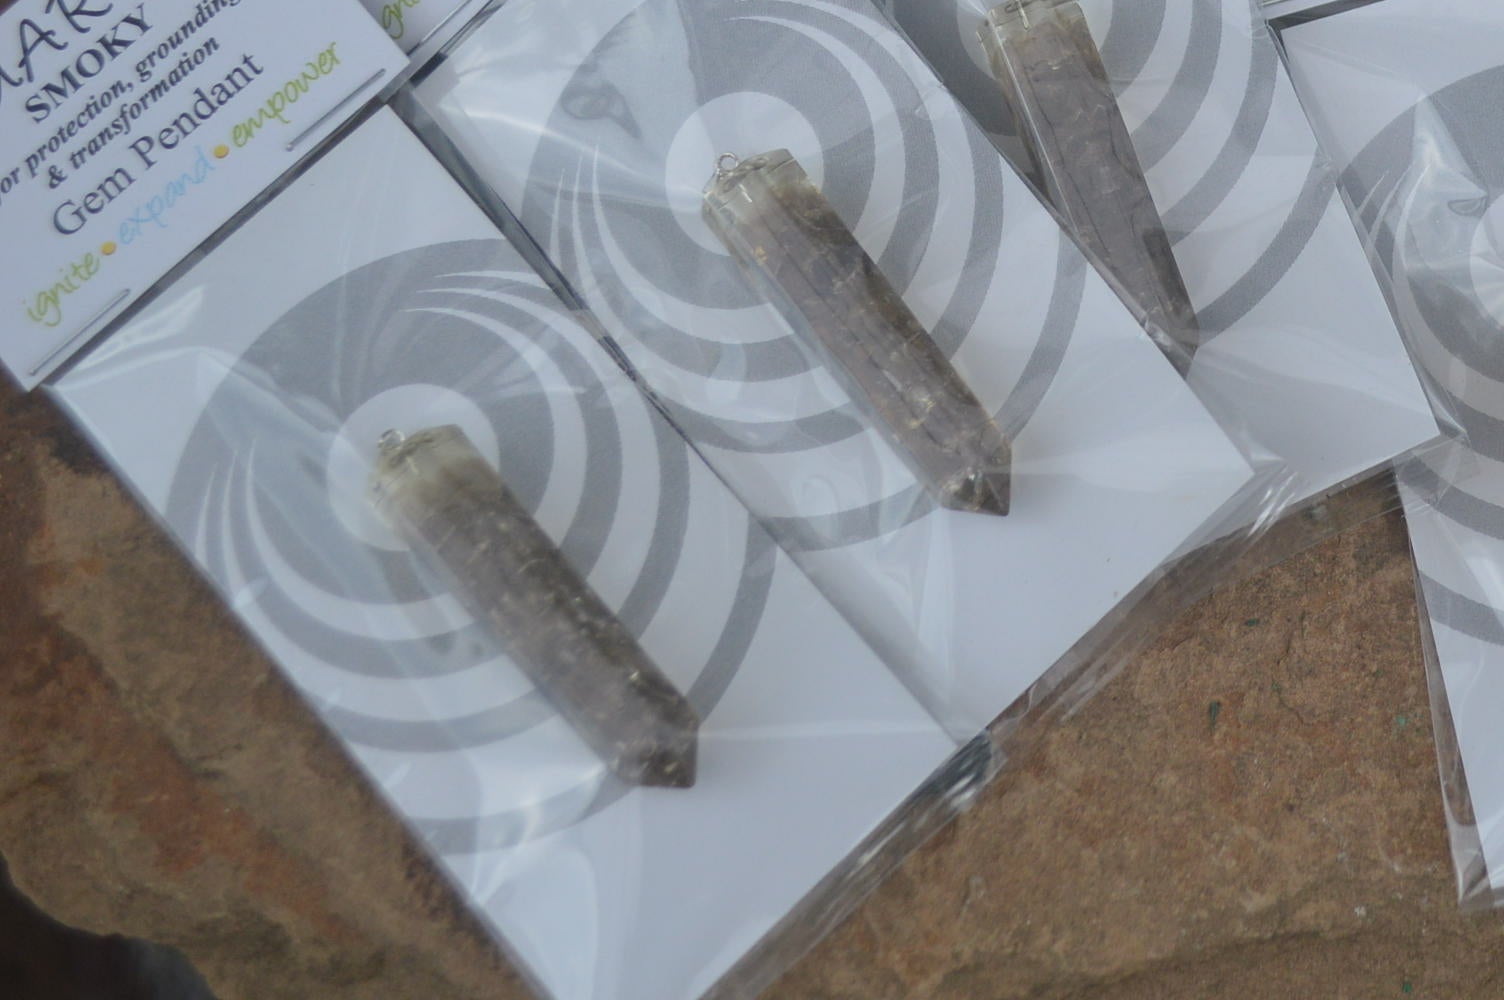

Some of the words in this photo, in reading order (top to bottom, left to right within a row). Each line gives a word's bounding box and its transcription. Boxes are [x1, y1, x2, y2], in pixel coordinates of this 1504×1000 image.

[0, 166, 20, 196] or
[25, 80, 133, 178] protection,
[25, 3, 154, 124] SMOKY
[48, 165, 67, 190] &
[69, 37, 221, 170] transformation
[24, 252, 102, 328] ignite
[117, 155, 216, 245] expand
[231, 41, 343, 148] empower
[52, 167, 136, 235] Gem
[128, 53, 264, 169] Pendant
